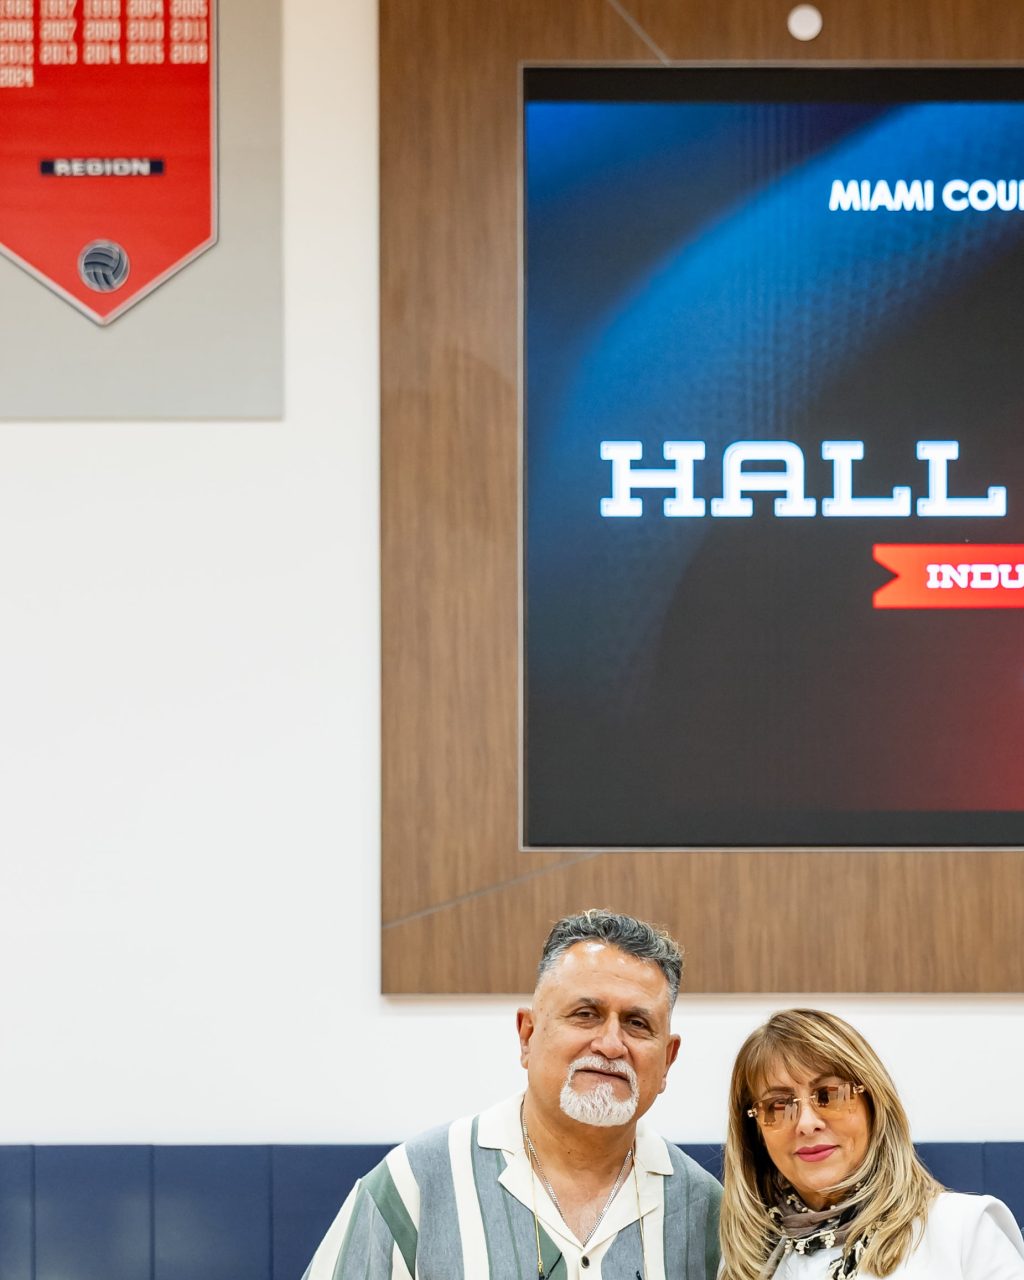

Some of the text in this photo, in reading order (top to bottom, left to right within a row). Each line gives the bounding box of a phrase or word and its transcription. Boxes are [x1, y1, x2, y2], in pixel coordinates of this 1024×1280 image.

[40, 19, 77, 42] 2007
[170, 19, 208, 42] 2011
[40, 42, 77, 65] 2013
[83, 42, 121, 65] 2014
[54, 158, 151, 176] REGION
[829, 180, 934, 211] MIAMI
[600, 440, 1007, 518] HALL
